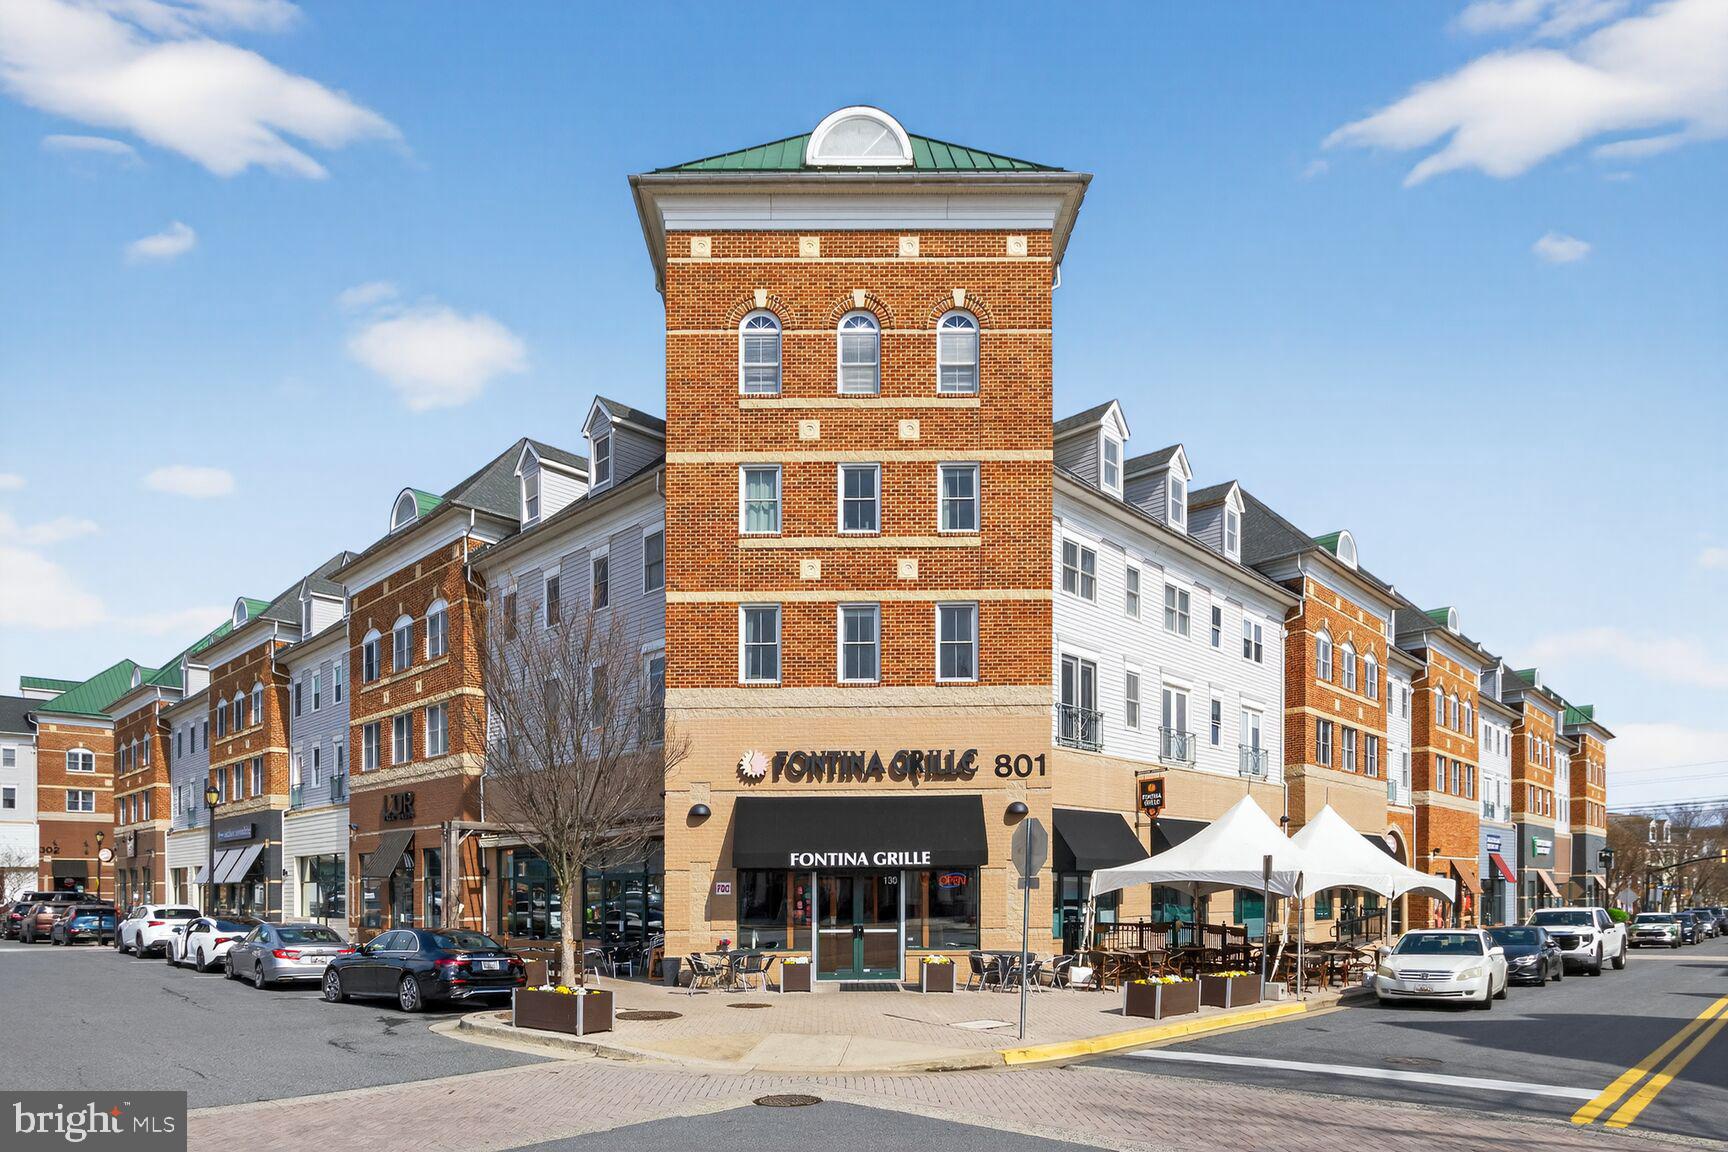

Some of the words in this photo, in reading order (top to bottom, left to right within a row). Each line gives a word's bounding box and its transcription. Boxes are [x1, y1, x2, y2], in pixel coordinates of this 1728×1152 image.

[772, 750, 886, 780] FONTINA
[889, 749, 979, 780] GRILLE
[994, 753, 1046, 778] 801
[790, 852, 869, 866] FONTINA
[873, 851, 931, 865] GRILLE
[883, 876, 898, 885] 130
